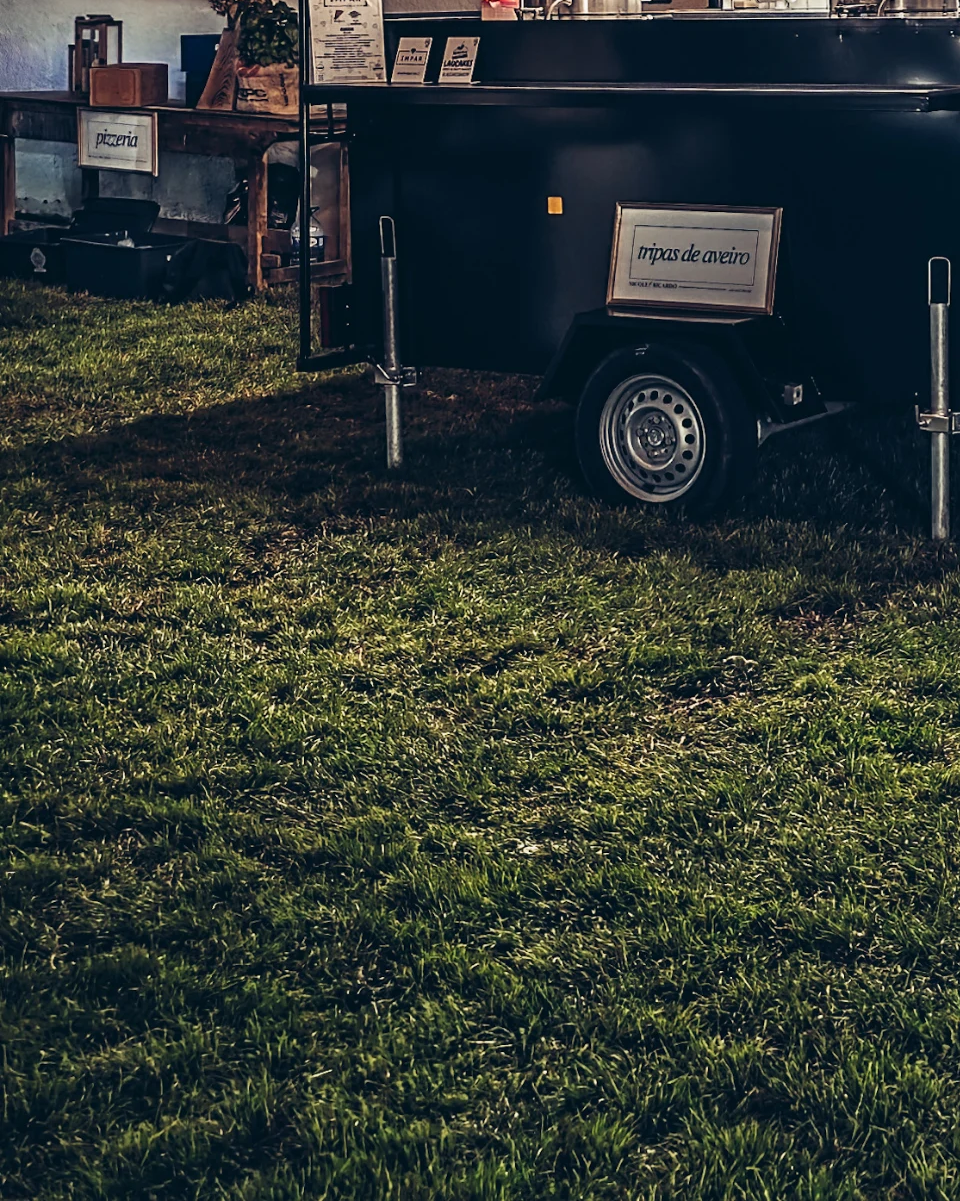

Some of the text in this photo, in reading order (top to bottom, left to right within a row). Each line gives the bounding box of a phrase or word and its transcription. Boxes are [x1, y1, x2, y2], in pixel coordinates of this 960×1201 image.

[95, 128, 139, 149] pizzeria
[637, 242, 751, 266] tripas de aveiro
